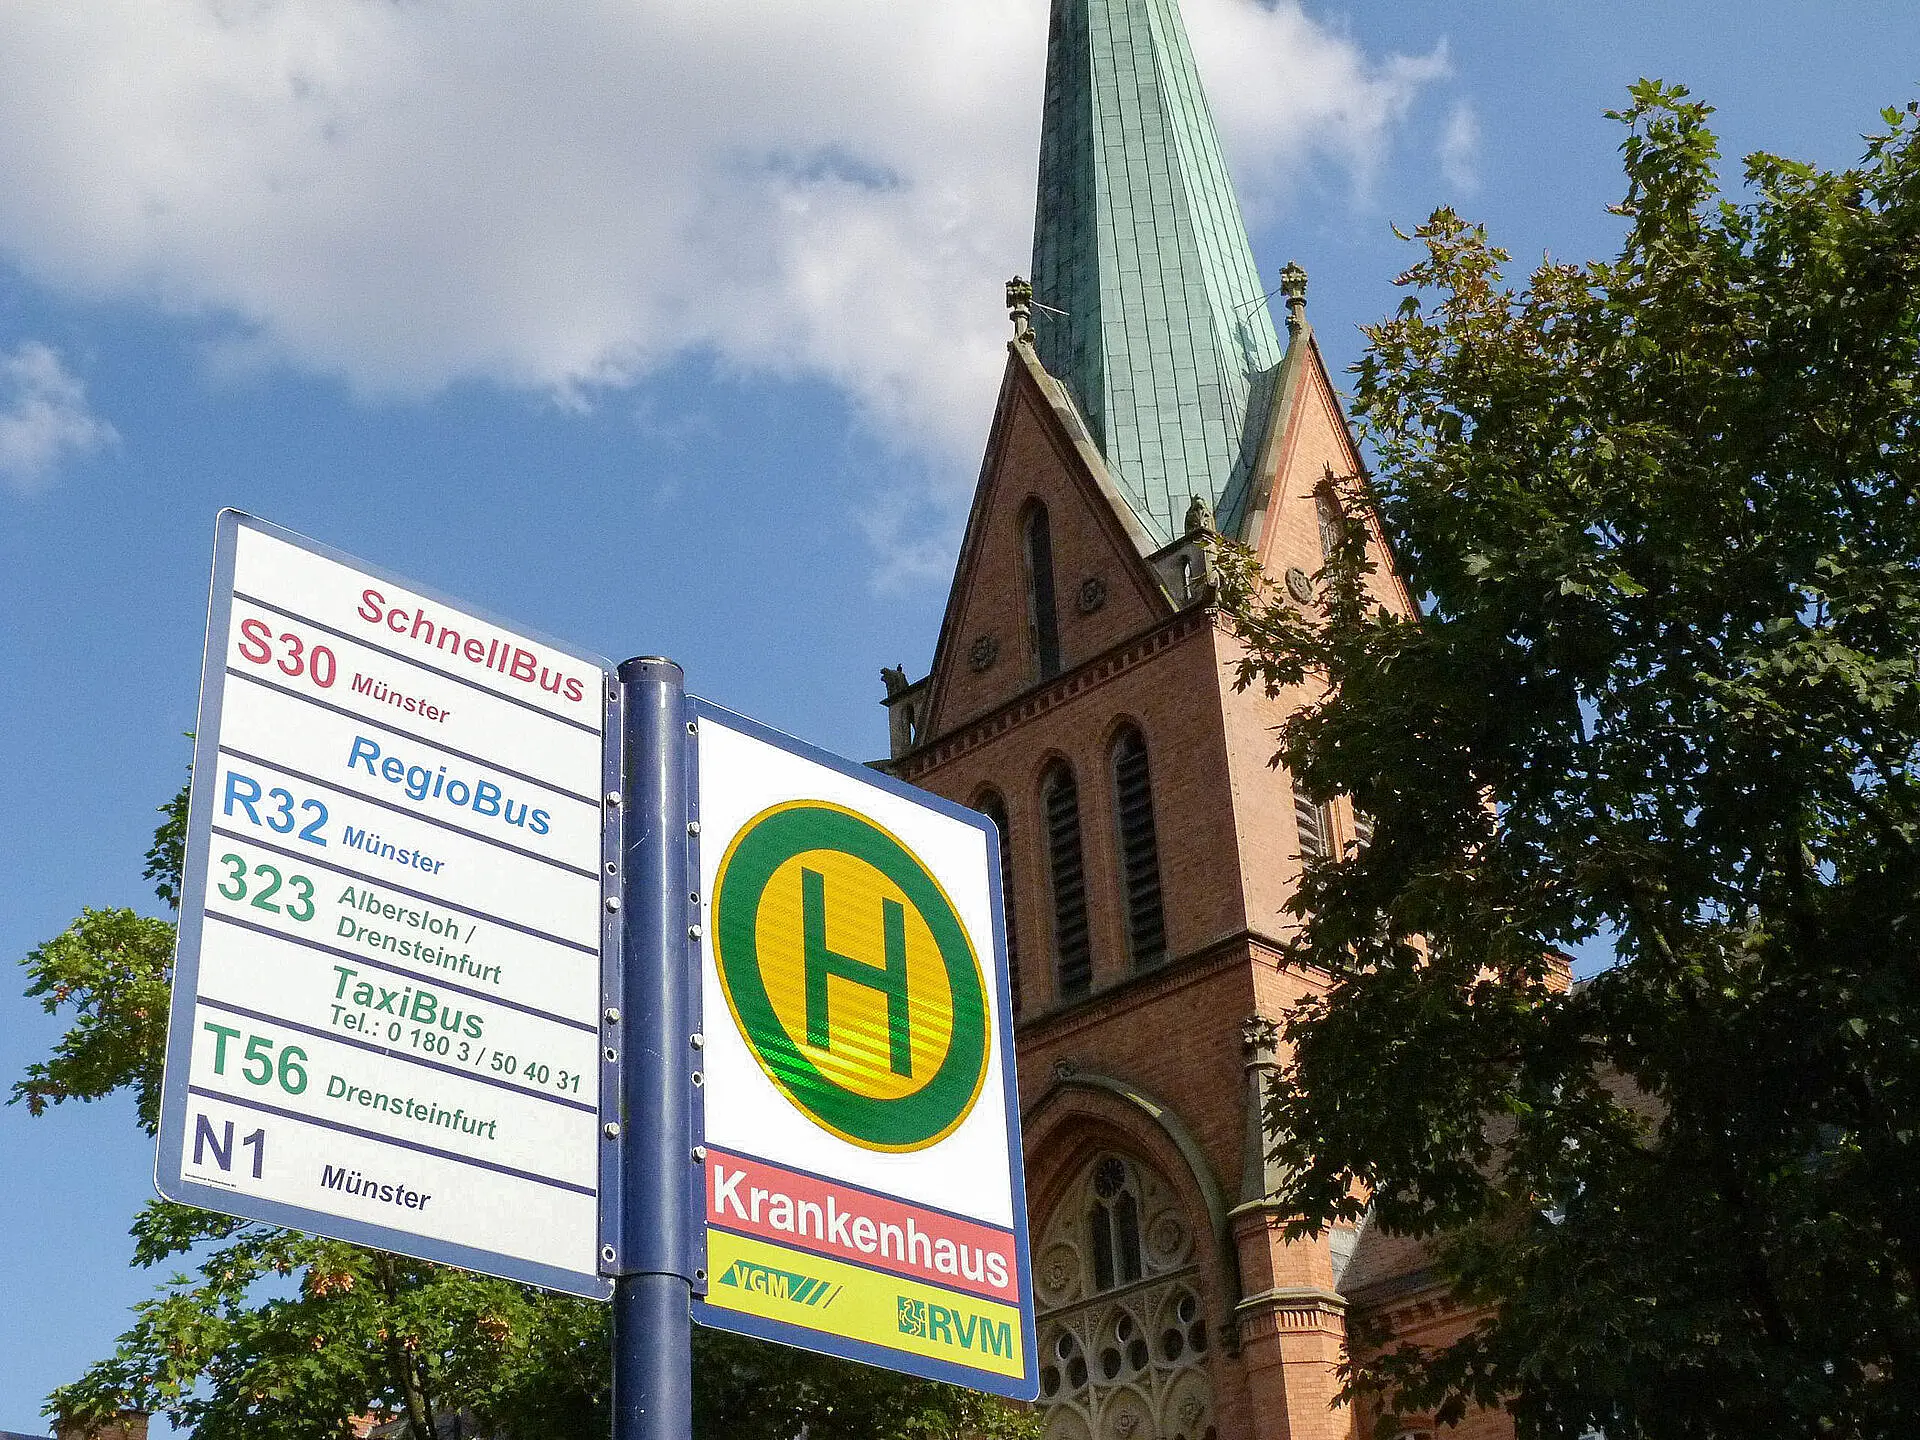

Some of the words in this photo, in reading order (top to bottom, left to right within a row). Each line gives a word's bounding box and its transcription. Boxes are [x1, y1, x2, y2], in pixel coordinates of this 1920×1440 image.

[238, 618, 336, 688] S30
[351, 673, 450, 724] Münster
[357, 589, 584, 702] SchnellBus
[223, 770, 329, 847] R32
[343, 826, 445, 875] Münster
[347, 735, 551, 835] RegioBus
[217, 853, 316, 922] 323
[338, 885, 459, 940] Albersloh
[464, 926, 476, 943] /
[337, 916, 502, 985] Drensteinfurt
[802, 866, 912, 1079] H
[330, 1004, 378, 1037] Tel.:
[388, 1024, 402, 1042] 0
[411, 1028, 450, 1056] 180
[457, 1042, 470, 1062] 3
[475, 1047, 486, 1066] /
[491, 1051, 517, 1075] 50
[523, 1060, 550, 1085] 40
[556, 1070, 581, 1093] 31
[333, 966, 484, 1038] TaxiBus
[203, 1021, 309, 1095] T56
[326, 1075, 497, 1141] Drensteinfurt
[192, 1113, 266, 1179] N1
[320, 1165, 431, 1212] Münster
[713, 1164, 1009, 1288] Krankenhaus
[733, 1264, 789, 1299] VGM
[929, 1302, 1013, 1359] RVM
